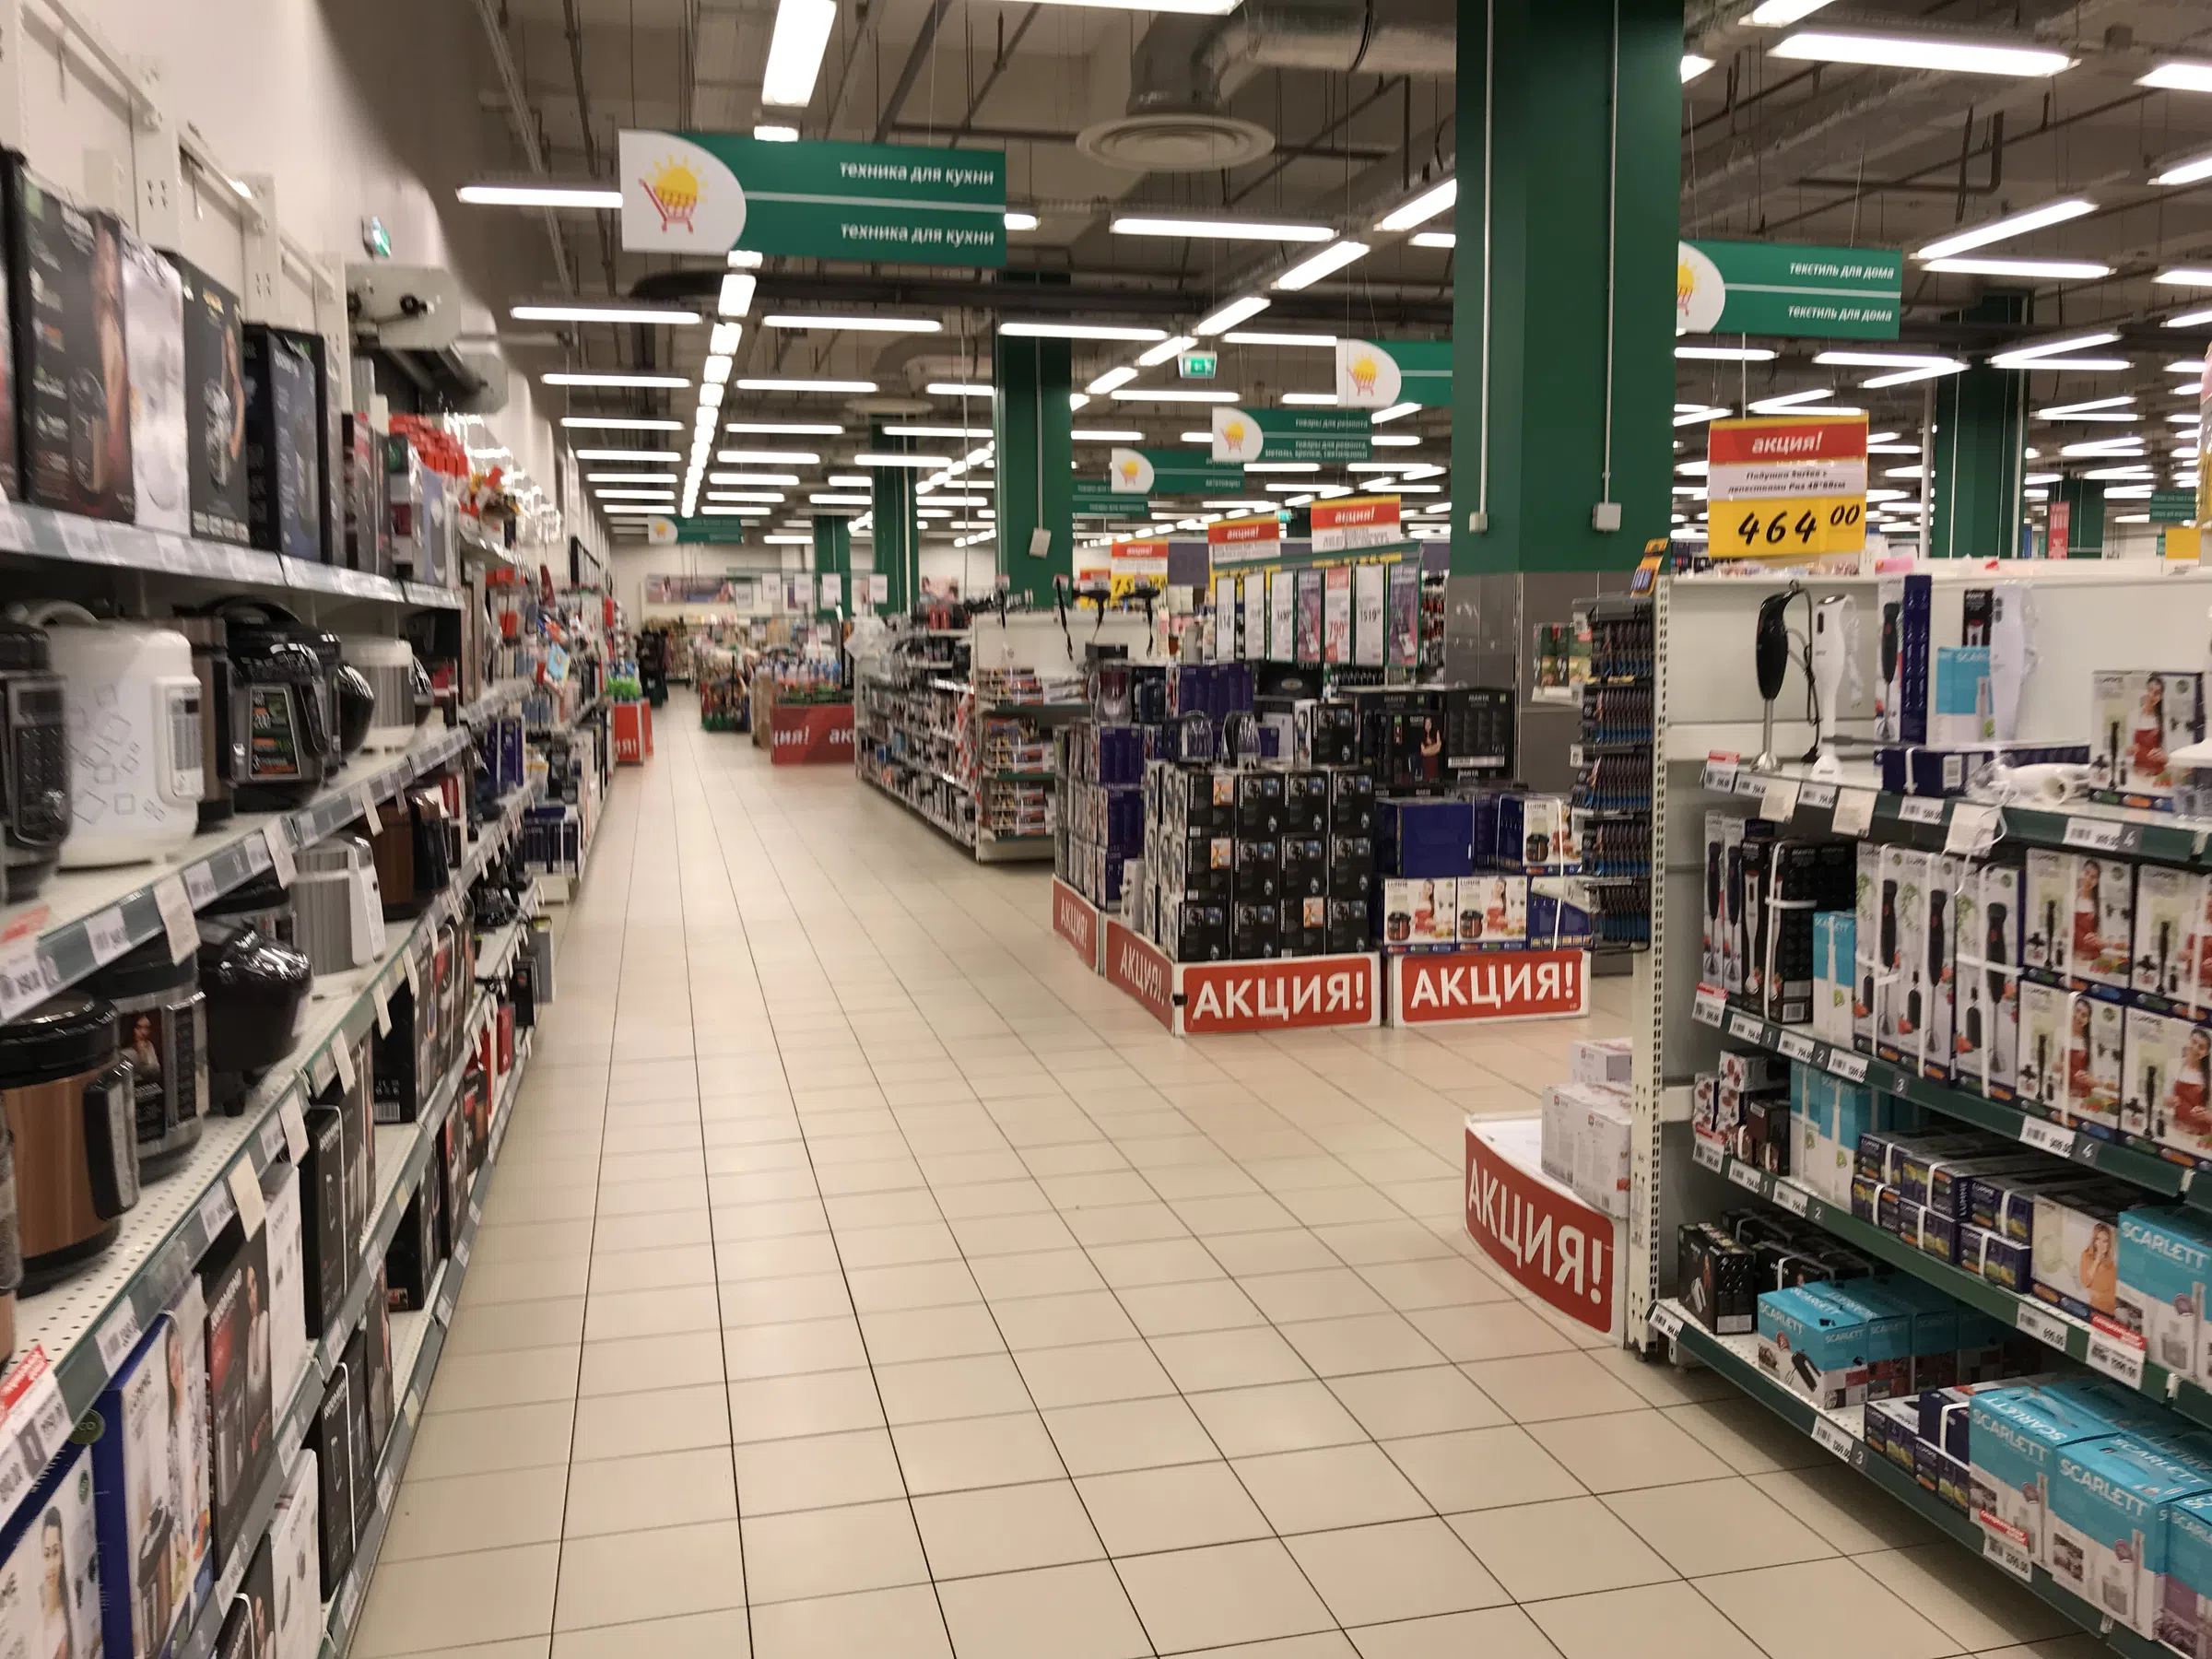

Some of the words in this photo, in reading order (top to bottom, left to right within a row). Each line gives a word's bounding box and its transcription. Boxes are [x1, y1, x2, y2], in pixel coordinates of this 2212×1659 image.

[841, 161, 907, 182] техника
[911, 166, 941, 183] для
[946, 168, 994, 187] кухни
[841, 222, 908, 242] техника
[912, 227, 942, 244] для
[947, 229, 994, 248] кухни
[1789, 262, 1839, 277] текстиль
[1840, 265, 1862, 279] для
[1863, 266, 1894, 280] дома
[1787, 305, 1837, 320] текстиль
[1838, 309, 1860, 323] для
[1861, 310, 1892, 323] дома
[1751, 430, 1823, 454] акция!
[1227, 525, 1259, 541] акция!
[1335, 506, 1375, 524] акция!
[1737, 509, 1818, 546] 464
[1830, 504, 1860, 526] 00
[1061, 896, 1088, 950] АКЦИЯ!
[1120, 940, 1164, 1006] АКЦИЯ!
[1410, 961, 1574, 1009] АКЦИЯ!
[1194, 971, 1365, 1021] АКЦИЯ!
[1468, 1158, 1604, 1305] АКЦИЯ!
[2121, 1221, 2210, 1269] SCARLETT
[1759, 1300, 1805, 1335] SCARLETT
[1972, 1409, 2049, 1463] SCARLETT
[1856, 1451, 1865, 1465] 3
[2110, 1439, 2206, 1484] SCARLETT
[2060, 1459, 2149, 1517] SCARLETT
